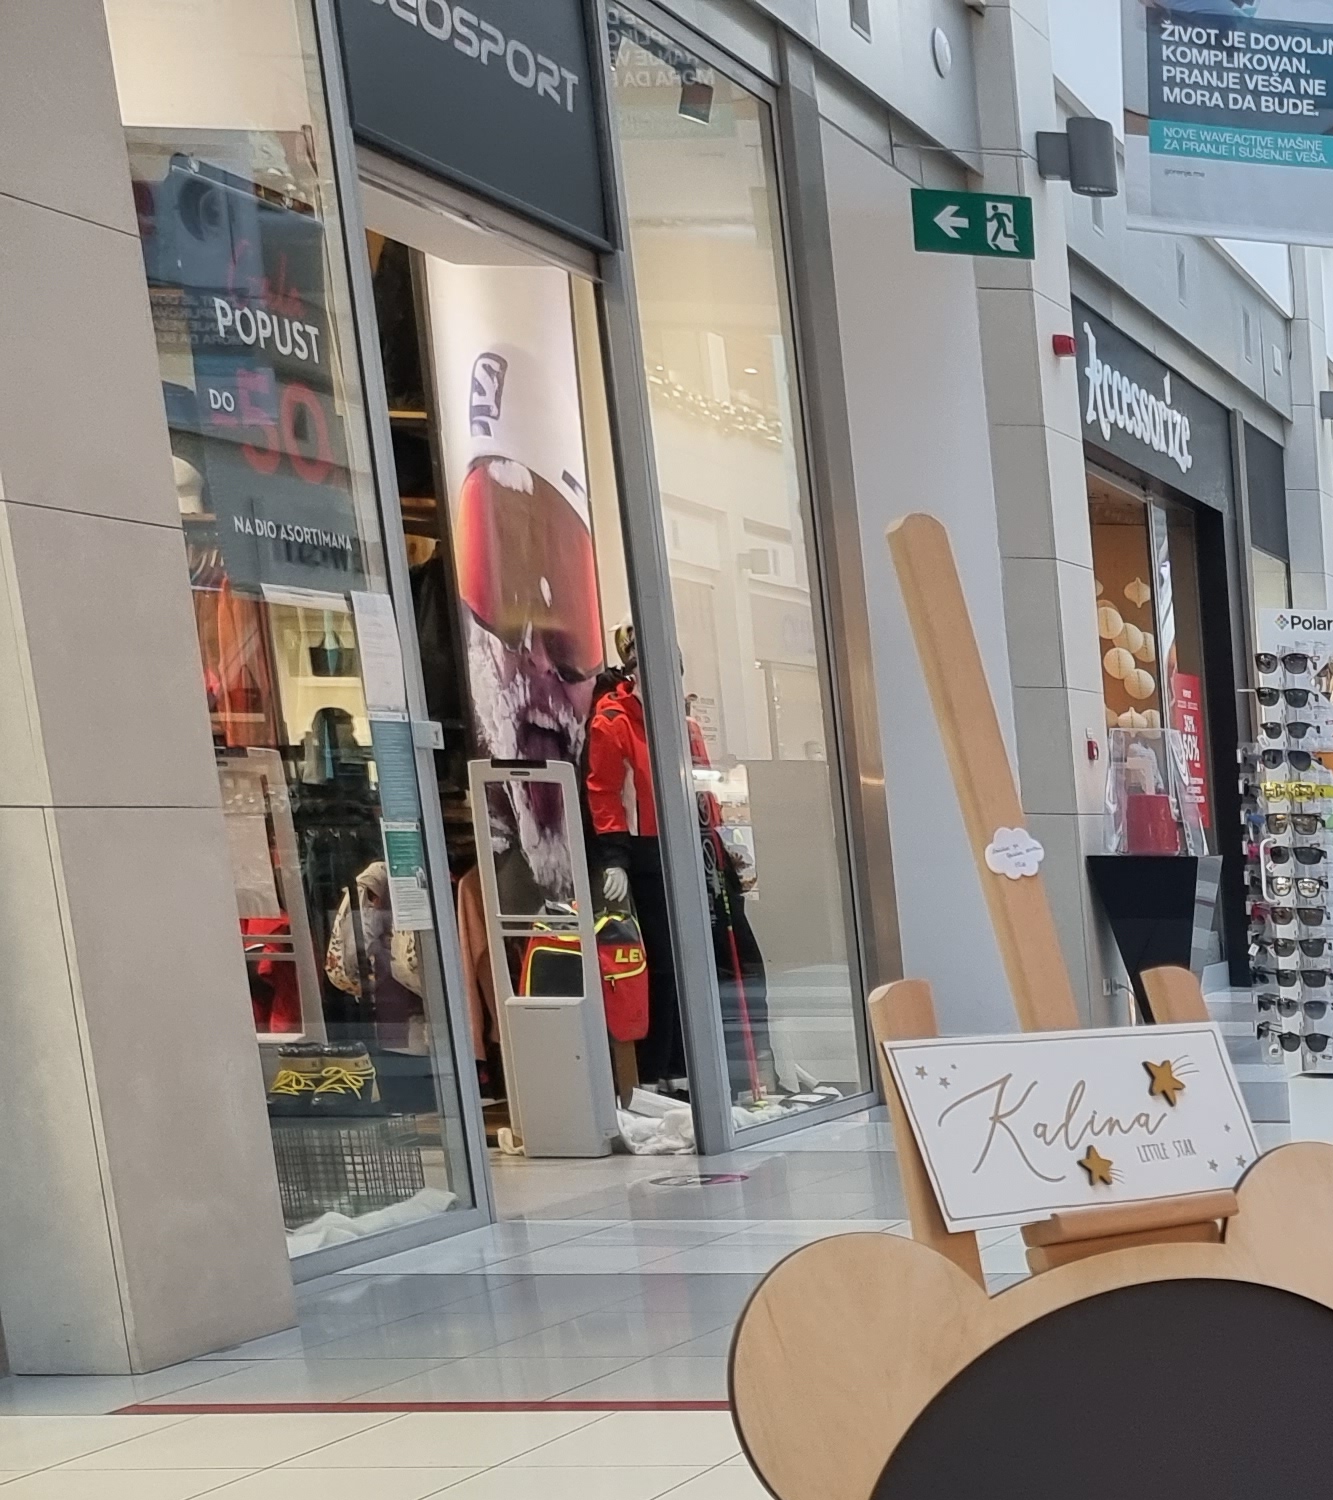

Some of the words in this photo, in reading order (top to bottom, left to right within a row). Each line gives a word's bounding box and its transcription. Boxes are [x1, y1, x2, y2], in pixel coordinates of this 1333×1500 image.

[1161, 20, 1219, 47] ŽIVOT
[1222, 31, 1246, 49] JE
[369, 0, 579, 113] EOSPORT
[1162, 45, 1310, 75] KOMPLIKOVAN.
[1162, 65, 1240, 89] PRANJE
[1245, 73, 1296, 94] VEŠA
[1300, 79, 1326, 96] NE
[1163, 86, 1224, 108] MORA
[1229, 94, 1257, 112] DA
[1260, 98, 1319, 116] BUDE.
[1164, 127, 1197, 140] NOVE
[1200, 130, 1274, 148] WAVEACTIVE
[1277, 136, 1322, 151] MAŠINE
[1164, 139, 1180, 151] ZA
[1182, 141, 1229, 156] PRANJE
[1239, 146, 1293, 161] SUŠENJE
[213, 297, 320, 364] POPUST
[208, 388, 235, 413] DO
[1083, 322, 1193, 473] Accessorize
[233, 516, 254, 535] NA
[255, 518, 277, 539] DIO
[281, 525, 353, 552] ASORTIMANA
[938, 1072, 1167, 1183] Kalina
[1136, 1142, 1170, 1164] LITTLE
[1173, 1138, 1197, 1160] STAR
